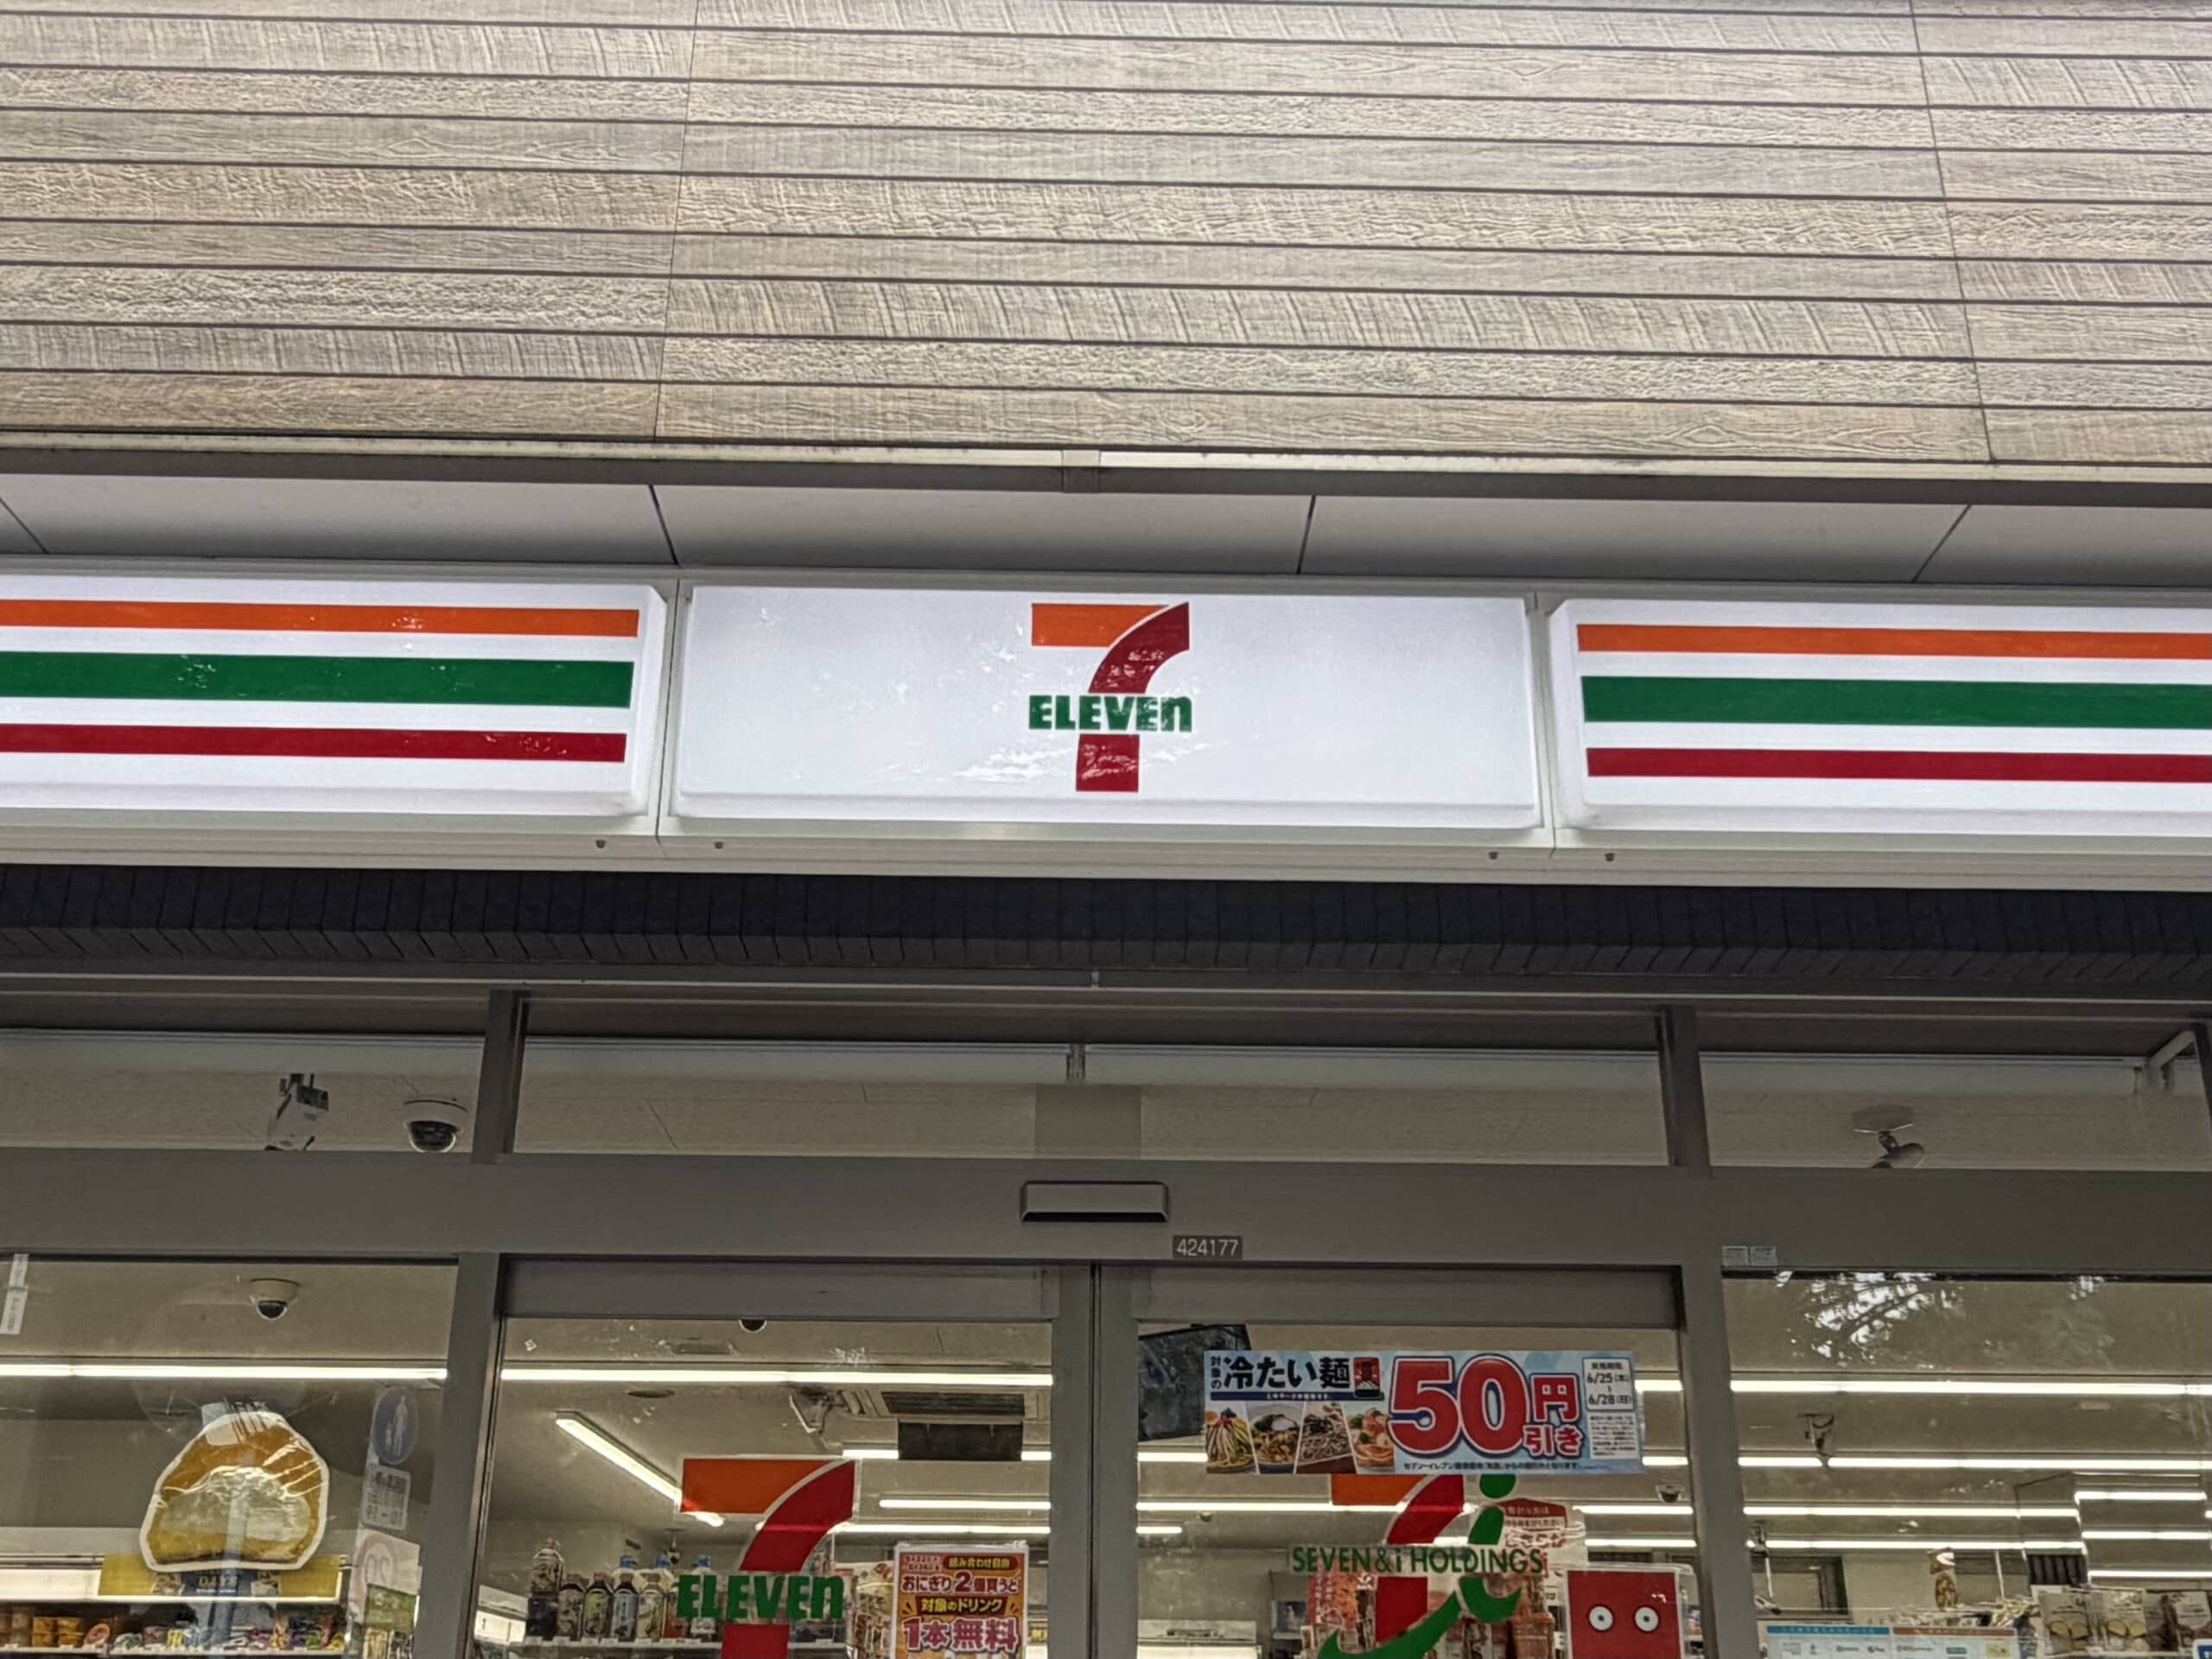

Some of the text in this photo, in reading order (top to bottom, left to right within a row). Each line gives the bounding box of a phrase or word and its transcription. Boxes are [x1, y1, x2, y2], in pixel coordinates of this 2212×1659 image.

[1177, 1237, 1238, 1256] 424177
[1224, 1356, 1351, 1389] 冷たい麺
[1411, 1548, 1544, 1573] HOLDINGS
[921, 1598, 1003, 1613] 対象のドリンク
[902, 1618, 1019, 1652] 1本無料
